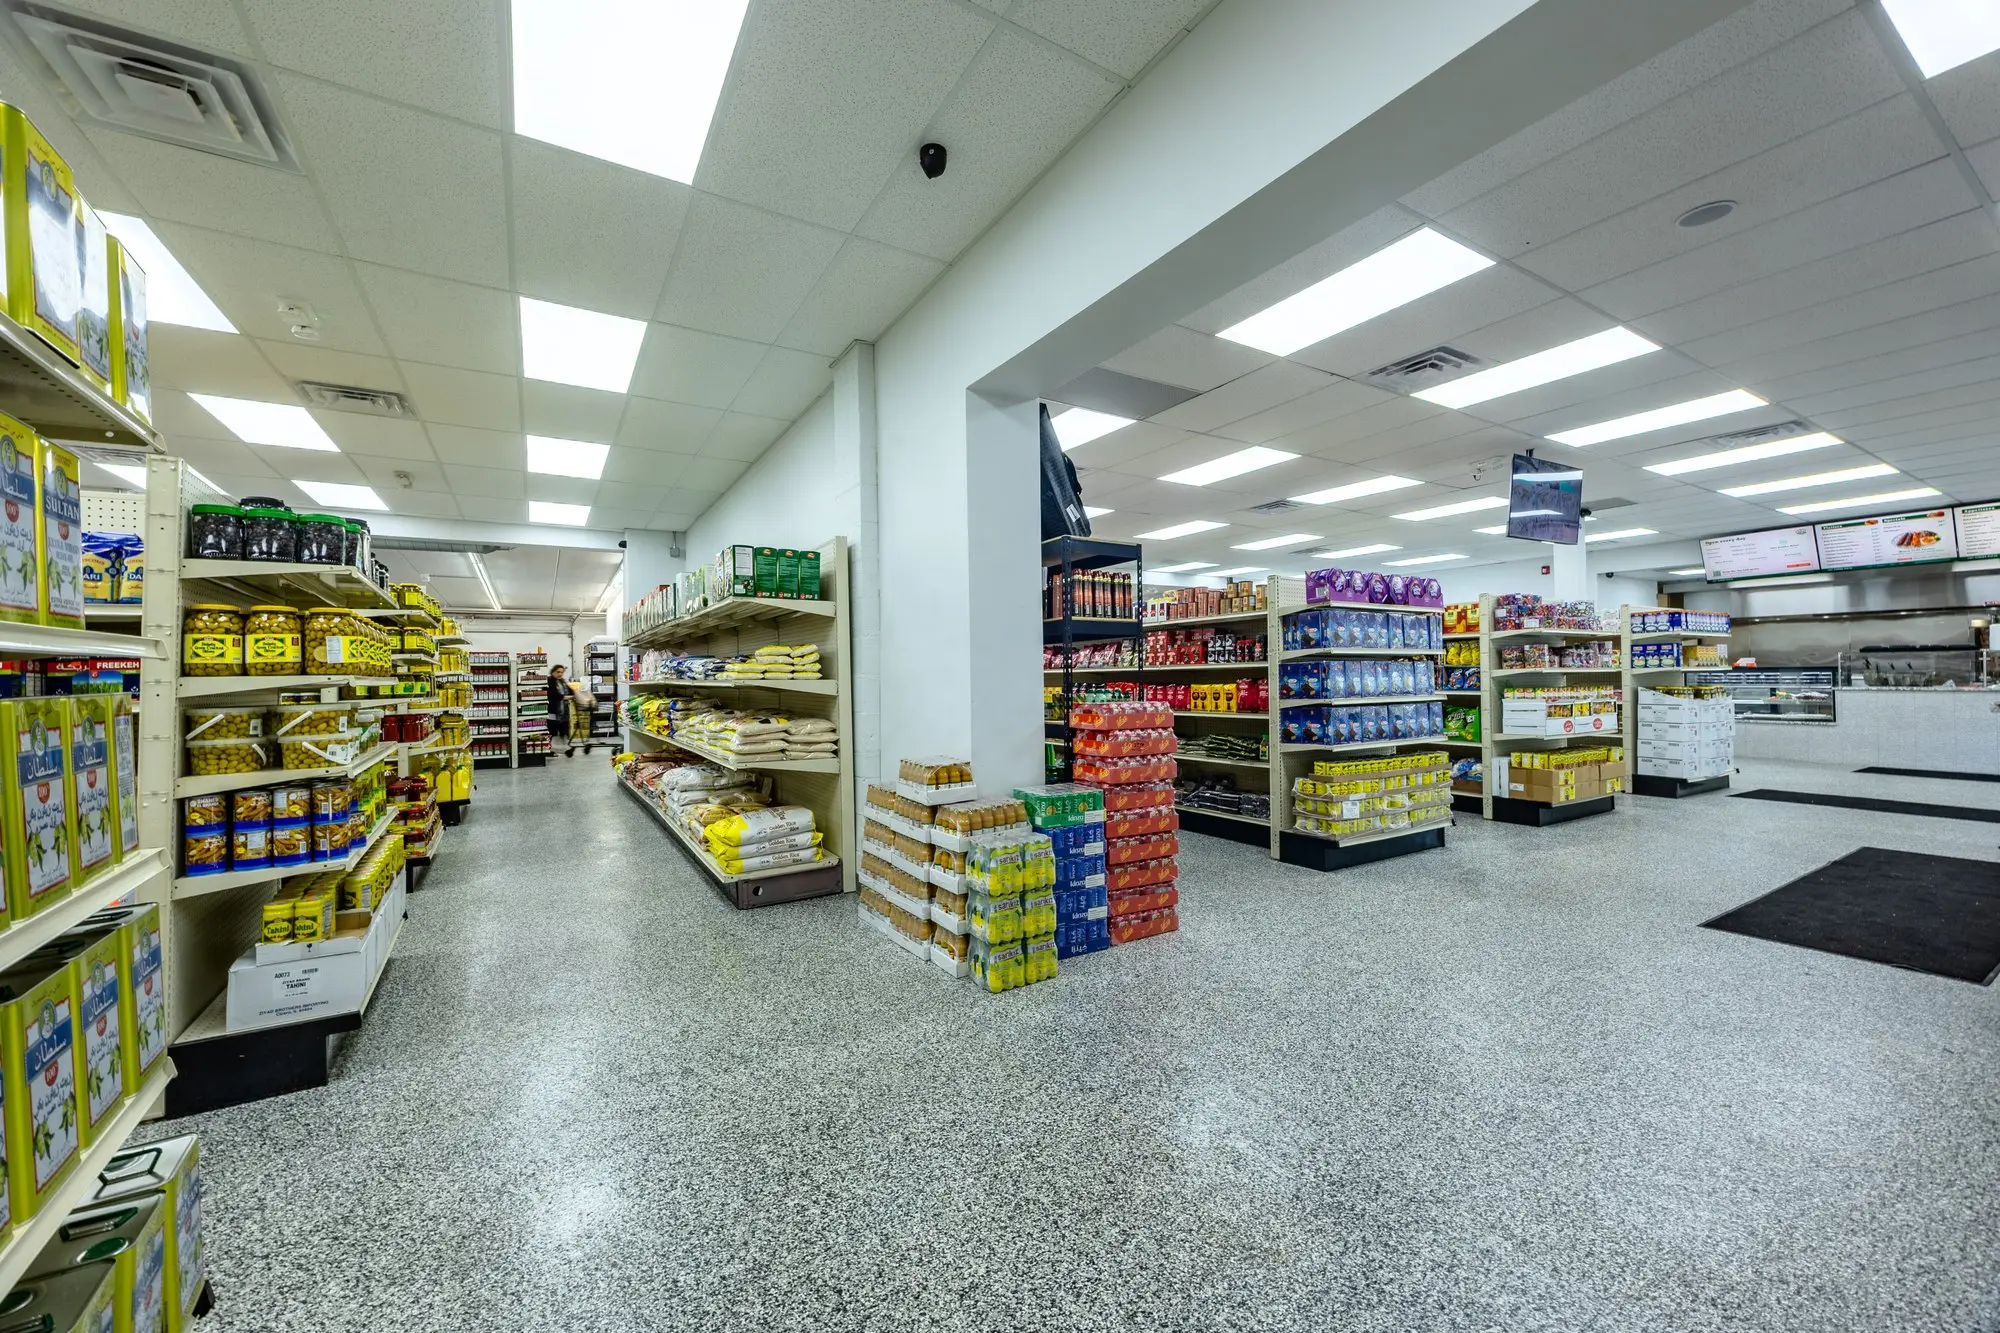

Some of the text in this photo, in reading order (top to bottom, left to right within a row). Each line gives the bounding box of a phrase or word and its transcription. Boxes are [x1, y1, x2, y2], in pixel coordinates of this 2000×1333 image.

[0, 476, 28, 501] سلطا
[45, 495, 80, 520] SULTAN
[96, 661, 140, 669] FREEKEH
[1068, 814, 1083, 822] kinza
[769, 823, 785, 831] Golden
[768, 839, 785, 847] Golden
[771, 853, 789, 861] Golden
[267, 925, 290, 934] Tahini
[295, 924, 314, 932] ahini
[275, 1004, 302, 1013] BROTHERS
